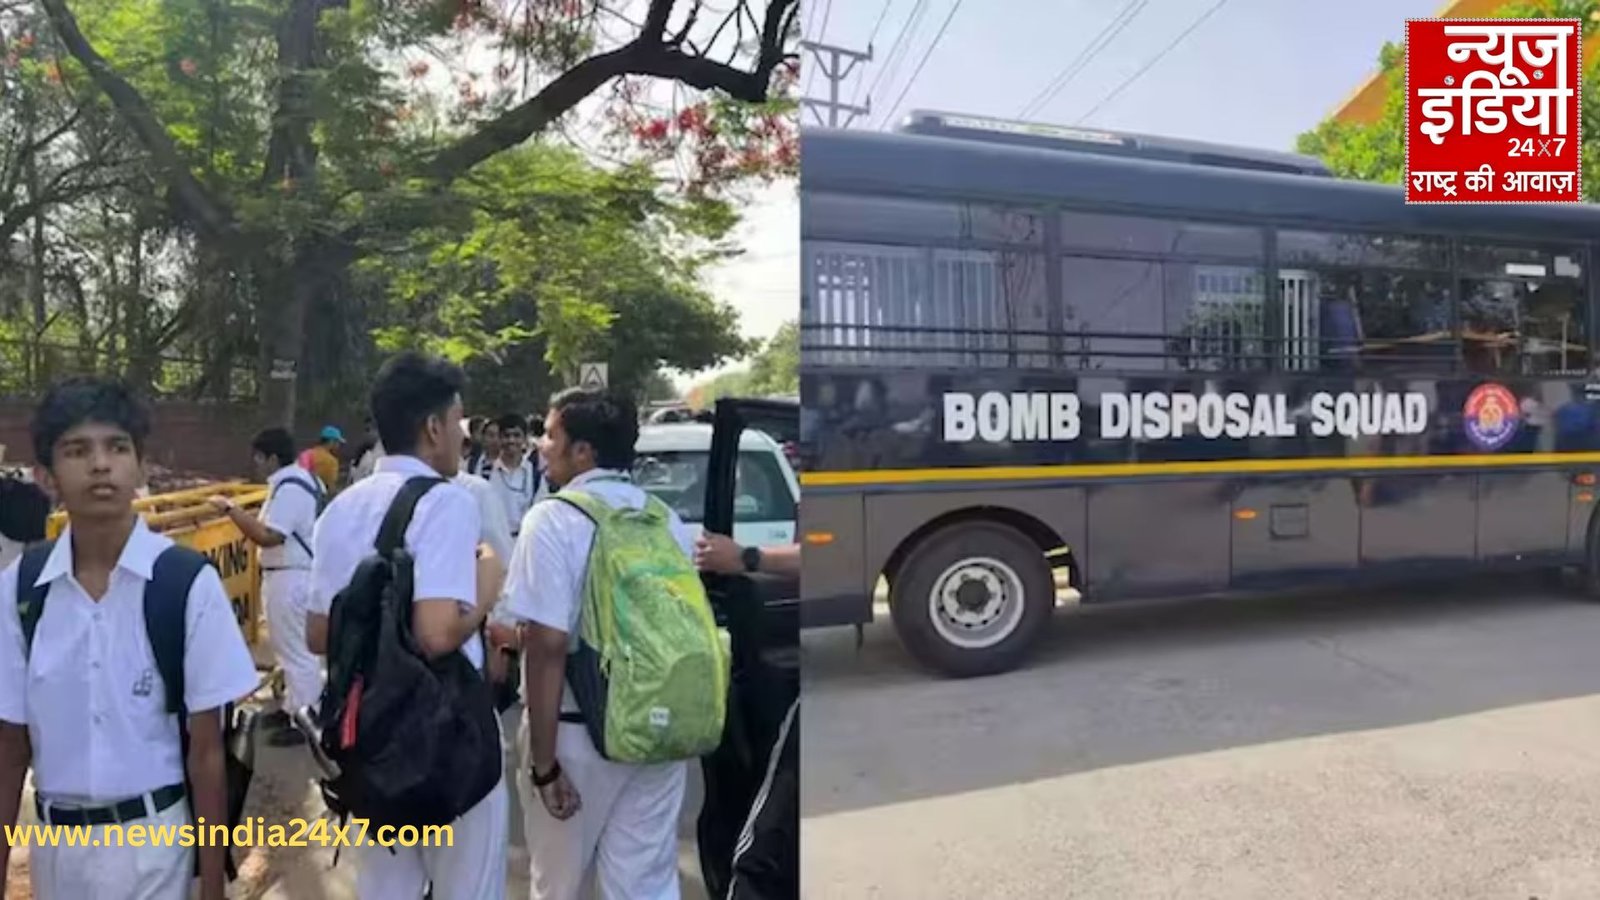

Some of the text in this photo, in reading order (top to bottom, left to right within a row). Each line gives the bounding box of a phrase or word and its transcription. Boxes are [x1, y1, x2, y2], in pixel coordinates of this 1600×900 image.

[943, 391, 1080, 441] BOMB
[1101, 391, 1296, 439] DISPOSAL
[1311, 392, 1427, 440] SQUAD
